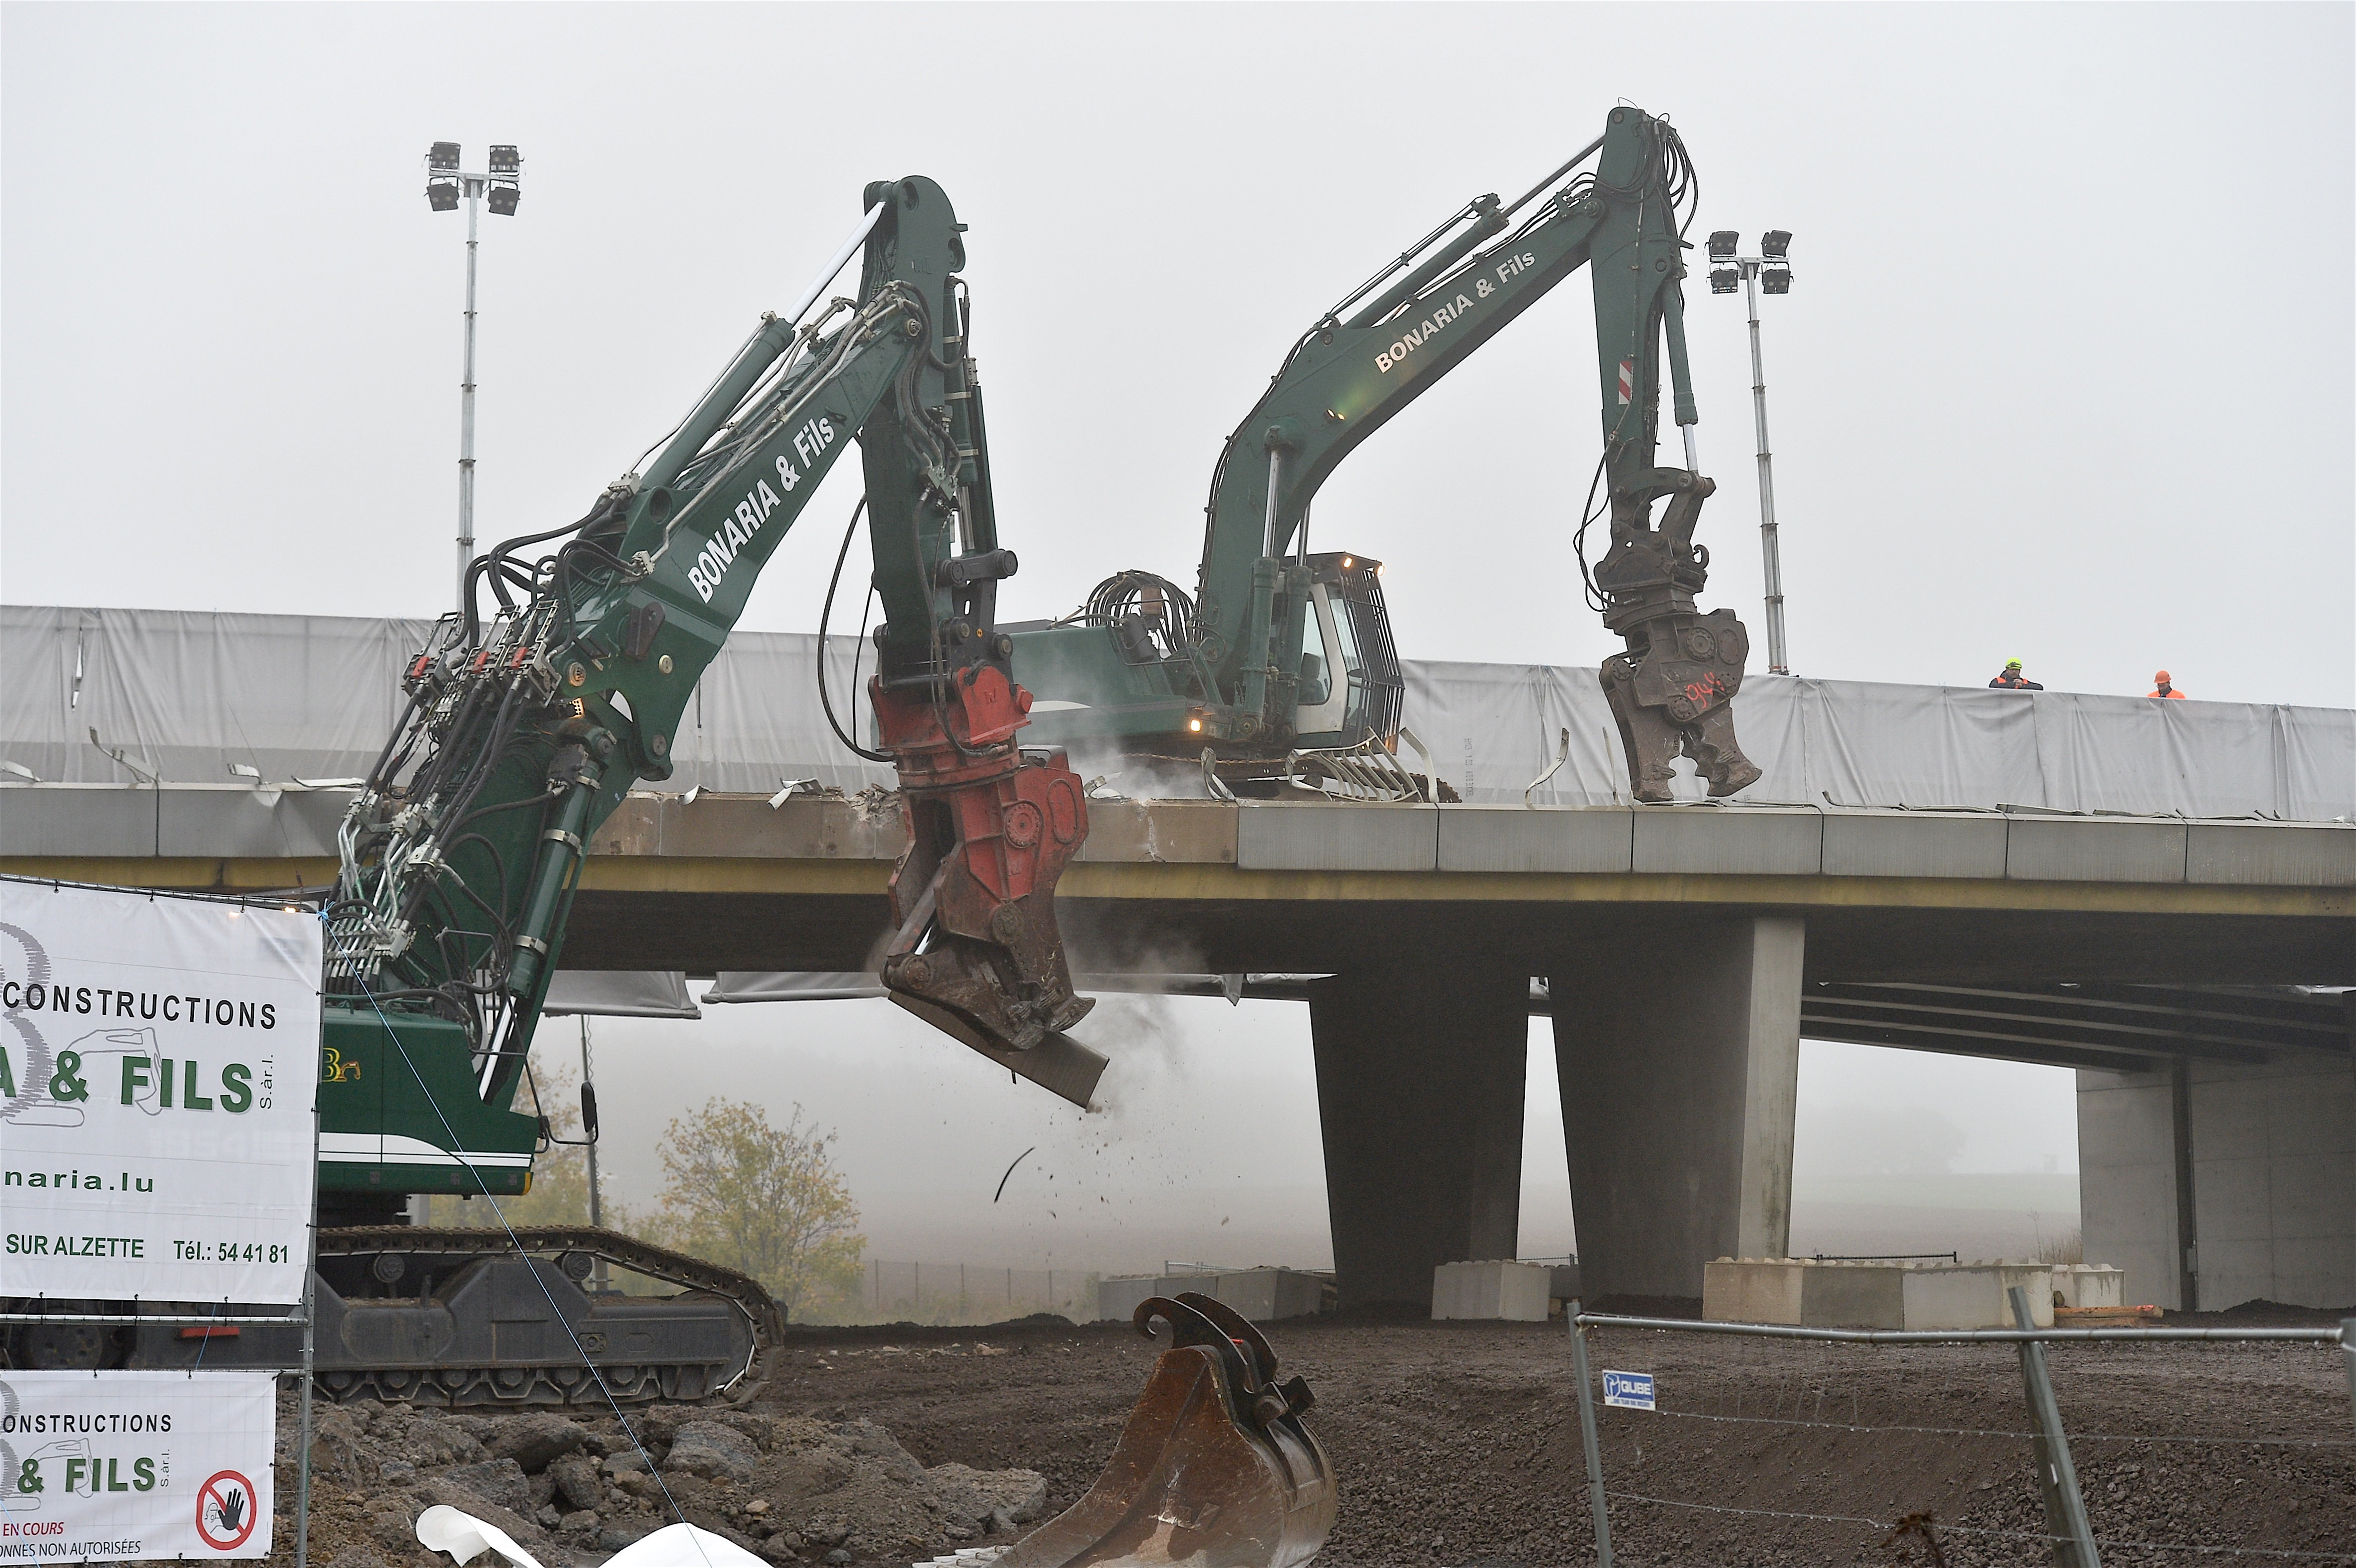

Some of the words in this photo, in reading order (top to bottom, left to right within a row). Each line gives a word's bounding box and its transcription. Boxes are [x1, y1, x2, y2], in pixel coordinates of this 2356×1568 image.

[1374, 293, 1475, 373] BONARIA
[1476, 279, 1496, 298] &
[1495, 252, 1536, 284] Fils
[687, 478, 781, 604] BONARIA
[775, 455, 802, 491] &
[793, 417, 835, 469] Fils
[3, 982, 276, 1030] CONSTRUCTIONS
[50, 1050, 89, 1102] &
[121, 1055, 252, 1112] FILS
[4, 1169, 153, 1192] naria.lu
[6, 1234, 48, 1255] SUR
[54, 1236, 144, 1258] ALZETTE
[173, 1240, 211, 1260] Tél.:
[218, 1243, 238, 1261] 54
[243, 1243, 262, 1262] 41
[269, 1245, 287, 1263] 81
[3, 1414, 172, 1433] ONSTRUCTIONS
[17, 1458, 44, 1493] &
[65, 1457, 155, 1492] FILS
[3, 1523, 19, 1536] EN
[23, 1522, 64, 1535] COURS
[0, 1544, 35, 1558] NNES
[39, 1543, 66, 1556] NON
[70, 1539, 141, 1555] AUTORISÉES
